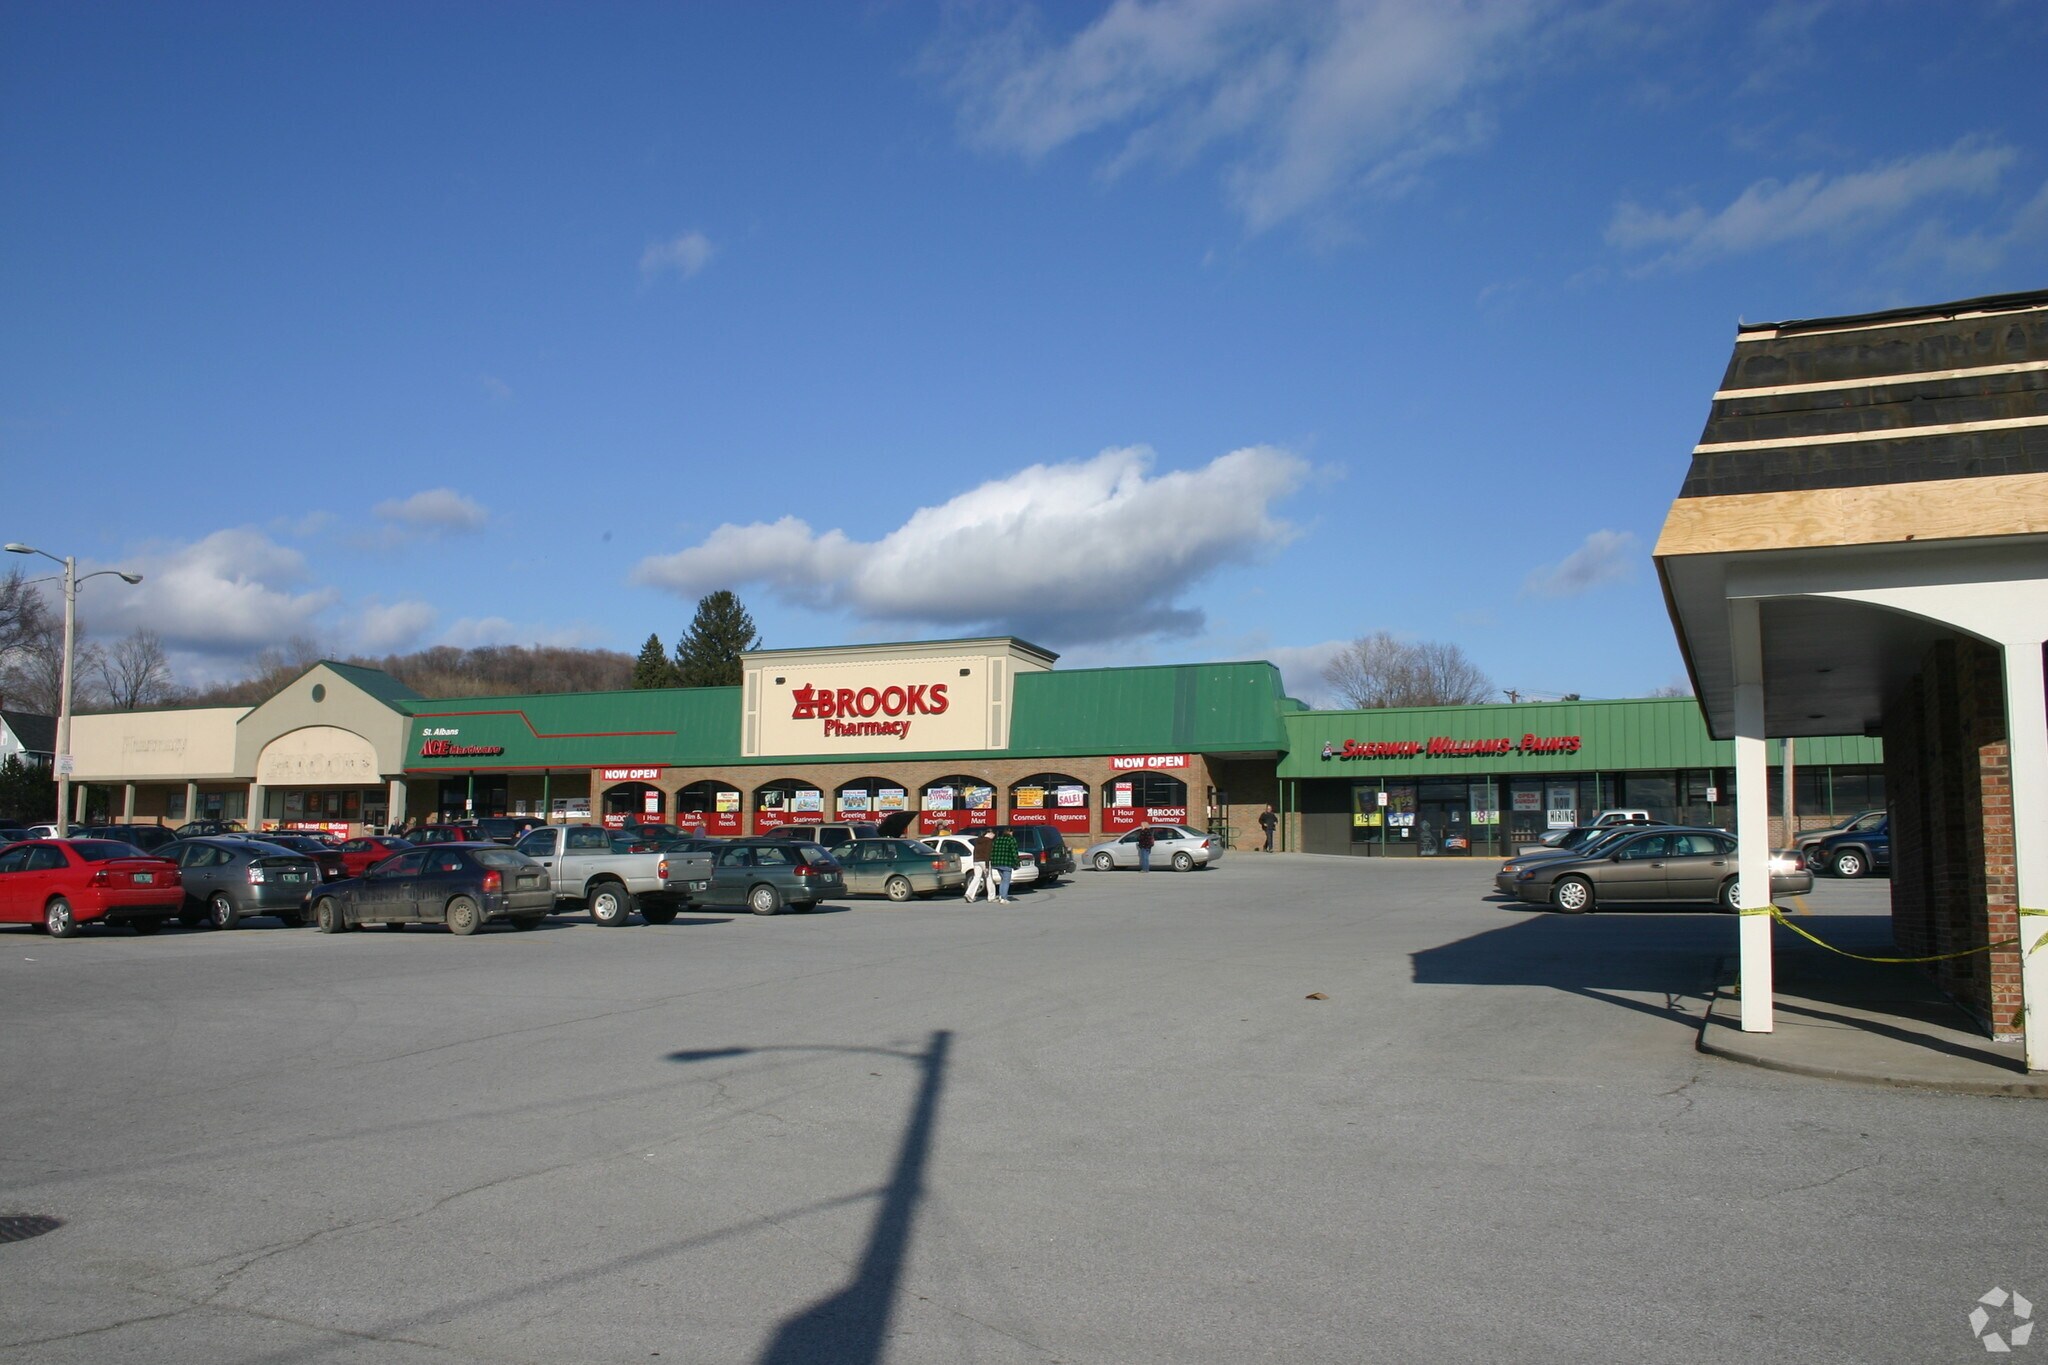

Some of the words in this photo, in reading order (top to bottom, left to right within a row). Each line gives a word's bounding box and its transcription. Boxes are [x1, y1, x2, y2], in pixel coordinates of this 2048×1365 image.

[817, 684, 949, 719] BROOKS
[422, 728, 432, 736] St.
[433, 728, 459, 736] Albans
[824, 719, 911, 740] Pharmacy
[420, 738, 449, 756] ACE
[1113, 757, 1145, 768] NOW
[1147, 756, 1184, 767] OPEN
[605, 769, 628, 779] NOW
[630, 769, 657, 779] OPEN
[1058, 794, 1080, 805] SALE!
[841, 812, 866, 820] Greeting
[1153, 808, 1186, 817] BROOKS
[1550, 810, 1575, 822] HIRING
[760, 819, 784, 827] Supplies
[1054, 814, 1087, 822] Fragrances
